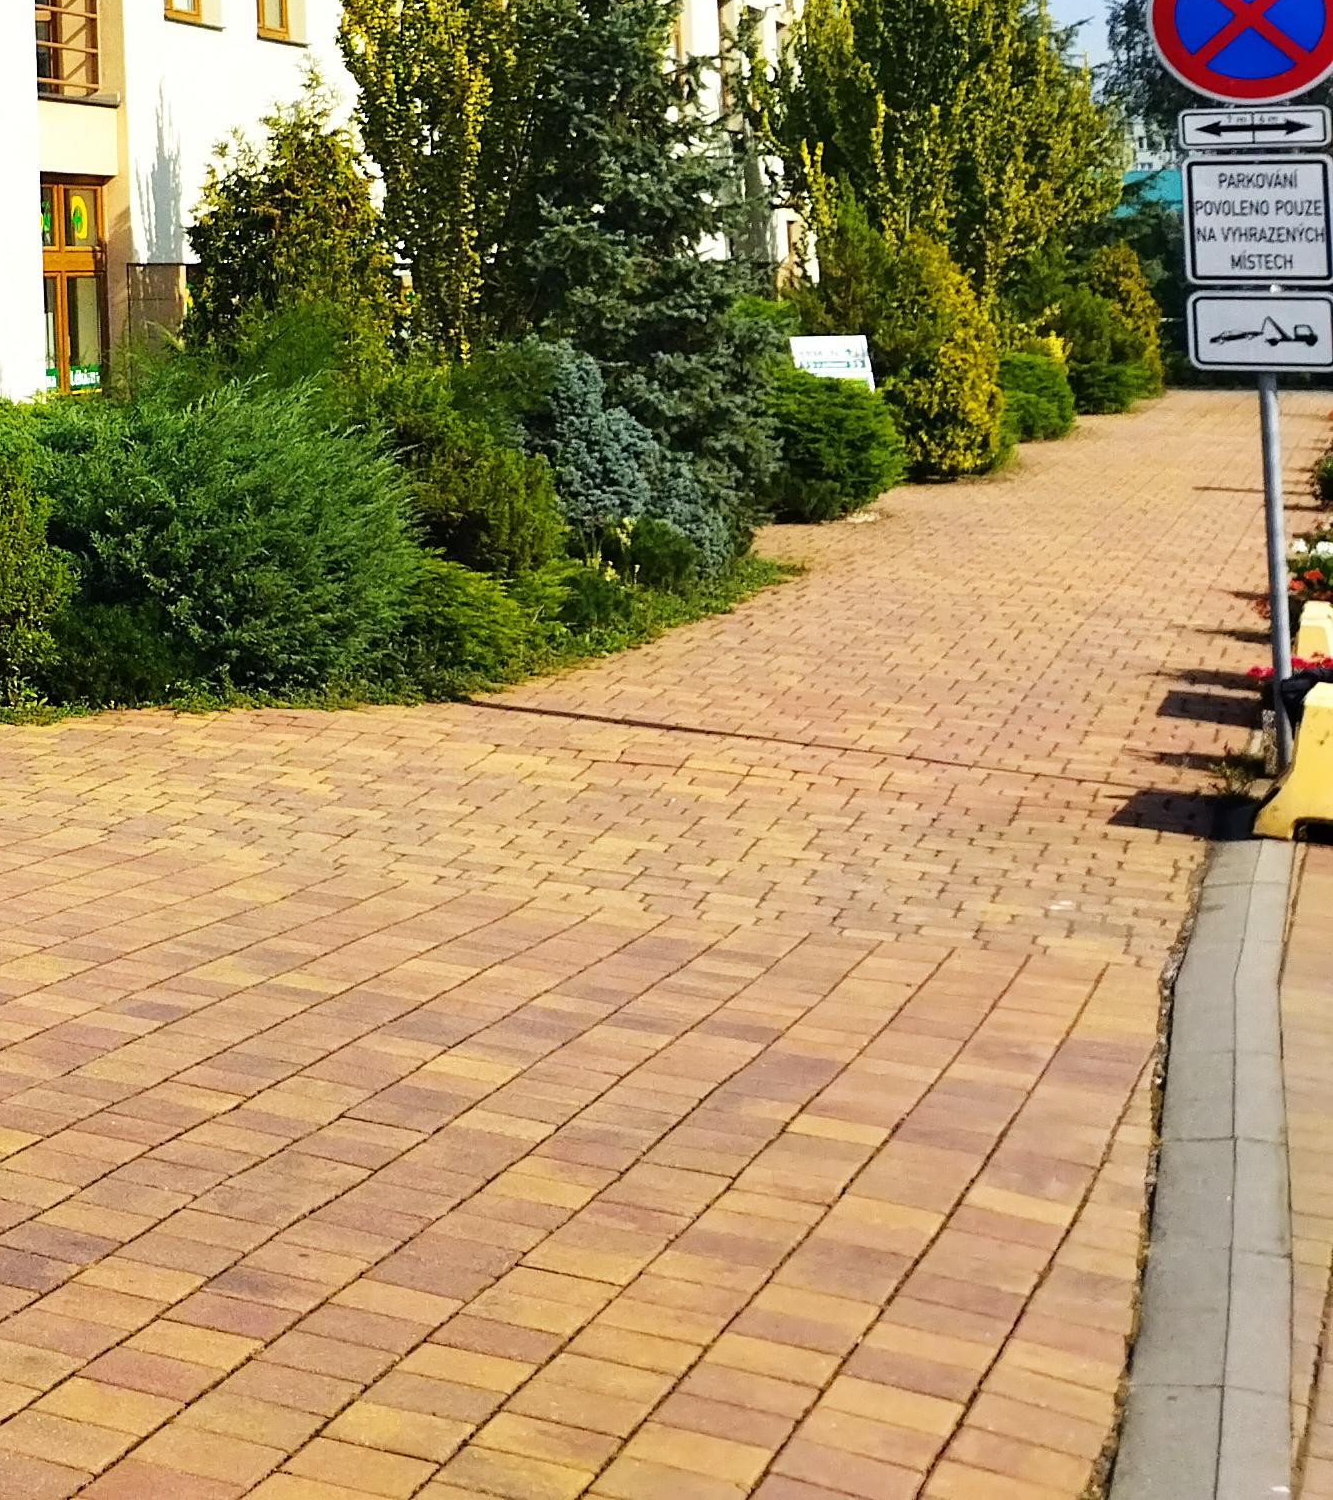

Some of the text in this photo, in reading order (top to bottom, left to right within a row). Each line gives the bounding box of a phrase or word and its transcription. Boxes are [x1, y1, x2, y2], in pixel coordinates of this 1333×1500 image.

[1218, 169, 1298, 189] PARKOVÁNÍ
[1195, 199, 1323, 217] POVOLENO POUZE
[1196, 223, 1326, 243] NA VYHRAZENÝCH
[1230, 250, 1294, 270] MÍSTECH
